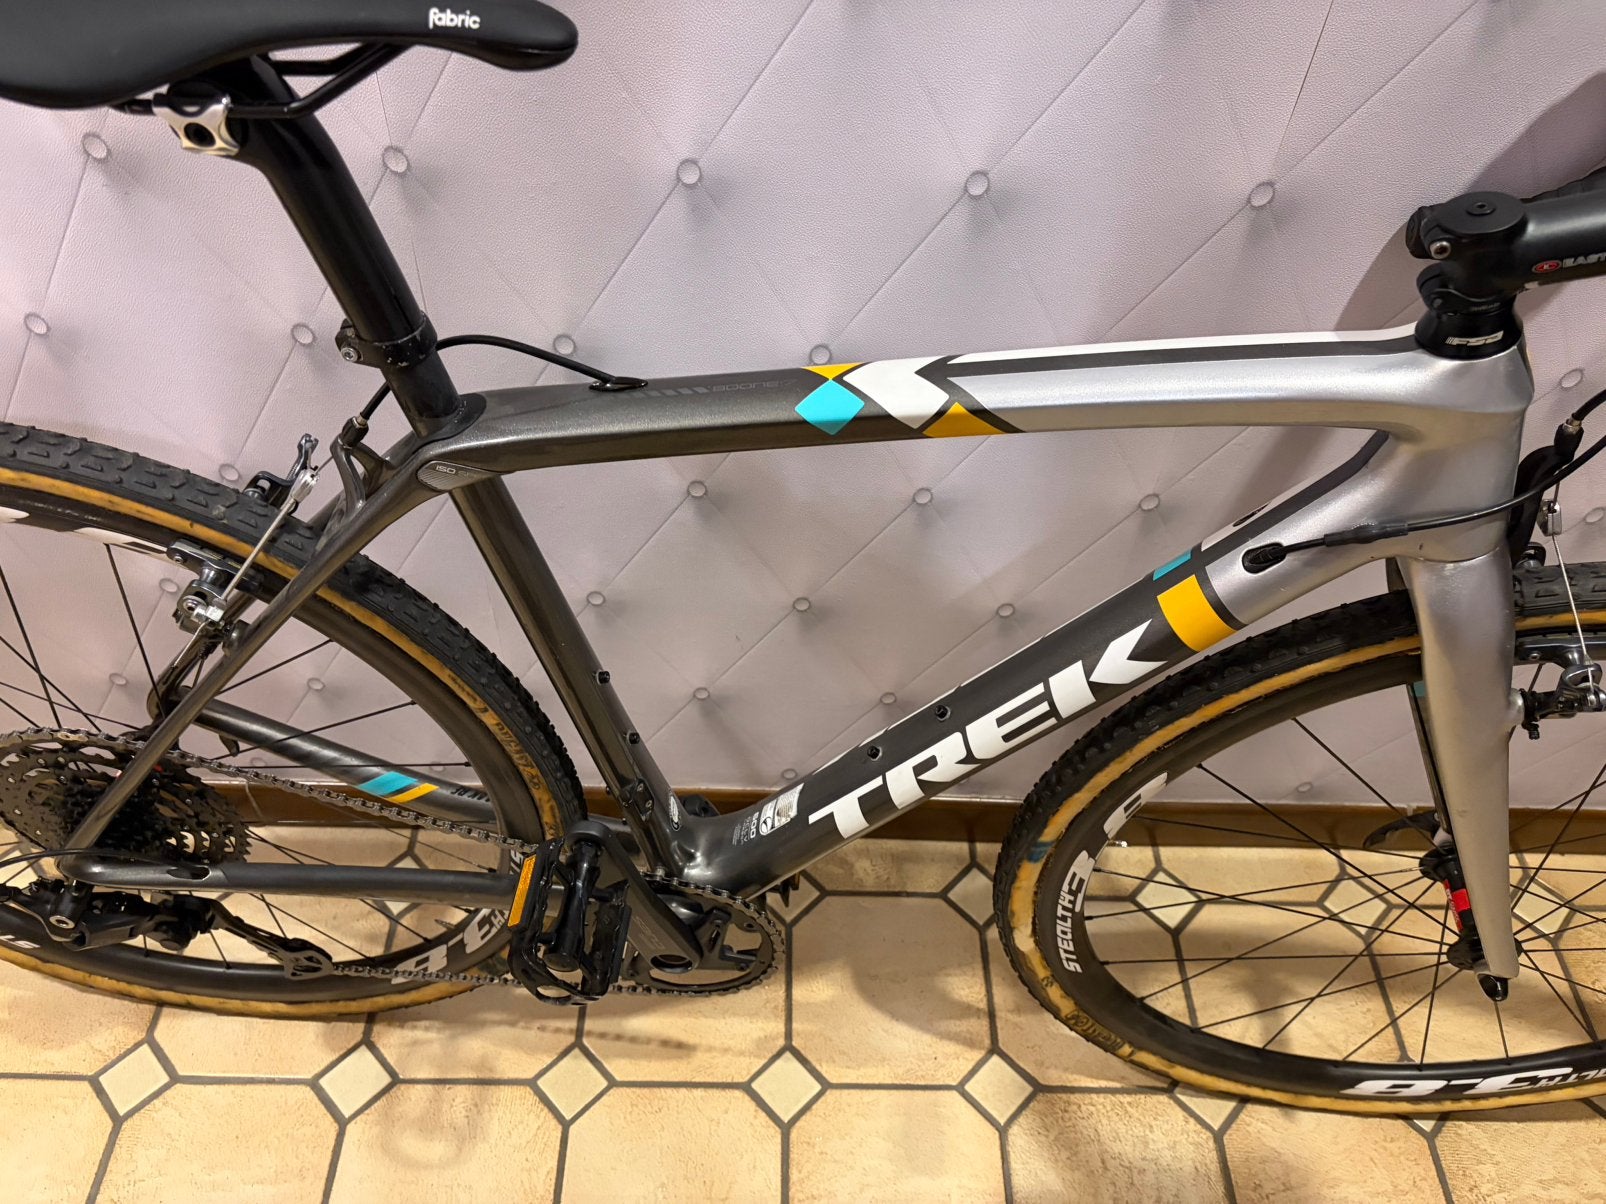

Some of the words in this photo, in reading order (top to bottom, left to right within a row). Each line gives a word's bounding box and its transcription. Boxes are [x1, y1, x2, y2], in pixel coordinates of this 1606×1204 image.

[429, 7, 480, 30] fabric
[1563, 251, 1606, 268] EAST
[808, 619, 1168, 839] TREK
[1055, 891, 1082, 973] STEALTH
